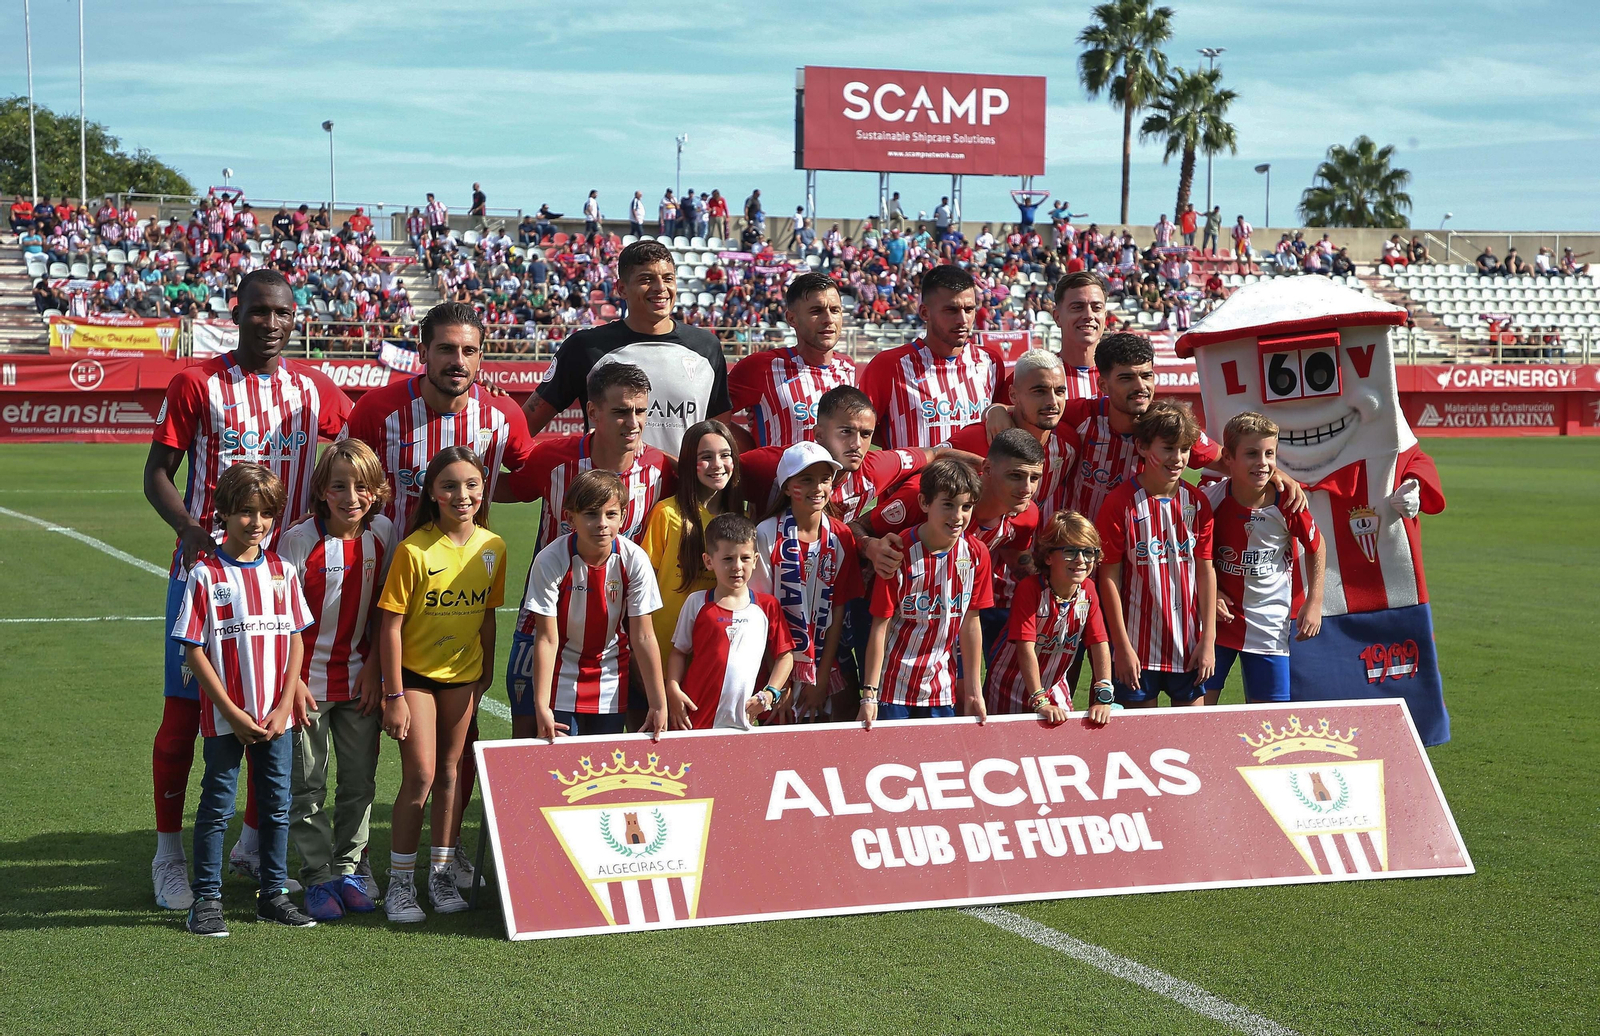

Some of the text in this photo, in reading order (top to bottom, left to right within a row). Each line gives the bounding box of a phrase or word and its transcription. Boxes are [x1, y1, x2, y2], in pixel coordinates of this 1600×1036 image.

[842, 81, 1010, 125] SCAMP
[856, 130, 996, 145] Sustainable Shipcare Solutions
[1221, 360, 1246, 395] L
[1346, 344, 1375, 378] V
[1453, 368, 1570, 387] CAPENERGY
[2, 401, 119, 424] etransit
[1444, 402, 1554, 413] Materiales de Construcción
[1444, 413, 1554, 427] AGUA MARINA
[222, 429, 307, 451] SCAMP
[903, 592, 970, 612] SCAMP
[214, 619, 291, 637] master.house
[765, 748, 1201, 820] ALGECIRAS
[851, 804, 1163, 870] CLUB DE FÚTBOL
[598, 859, 687, 875] ALGECIRAS C.F.
